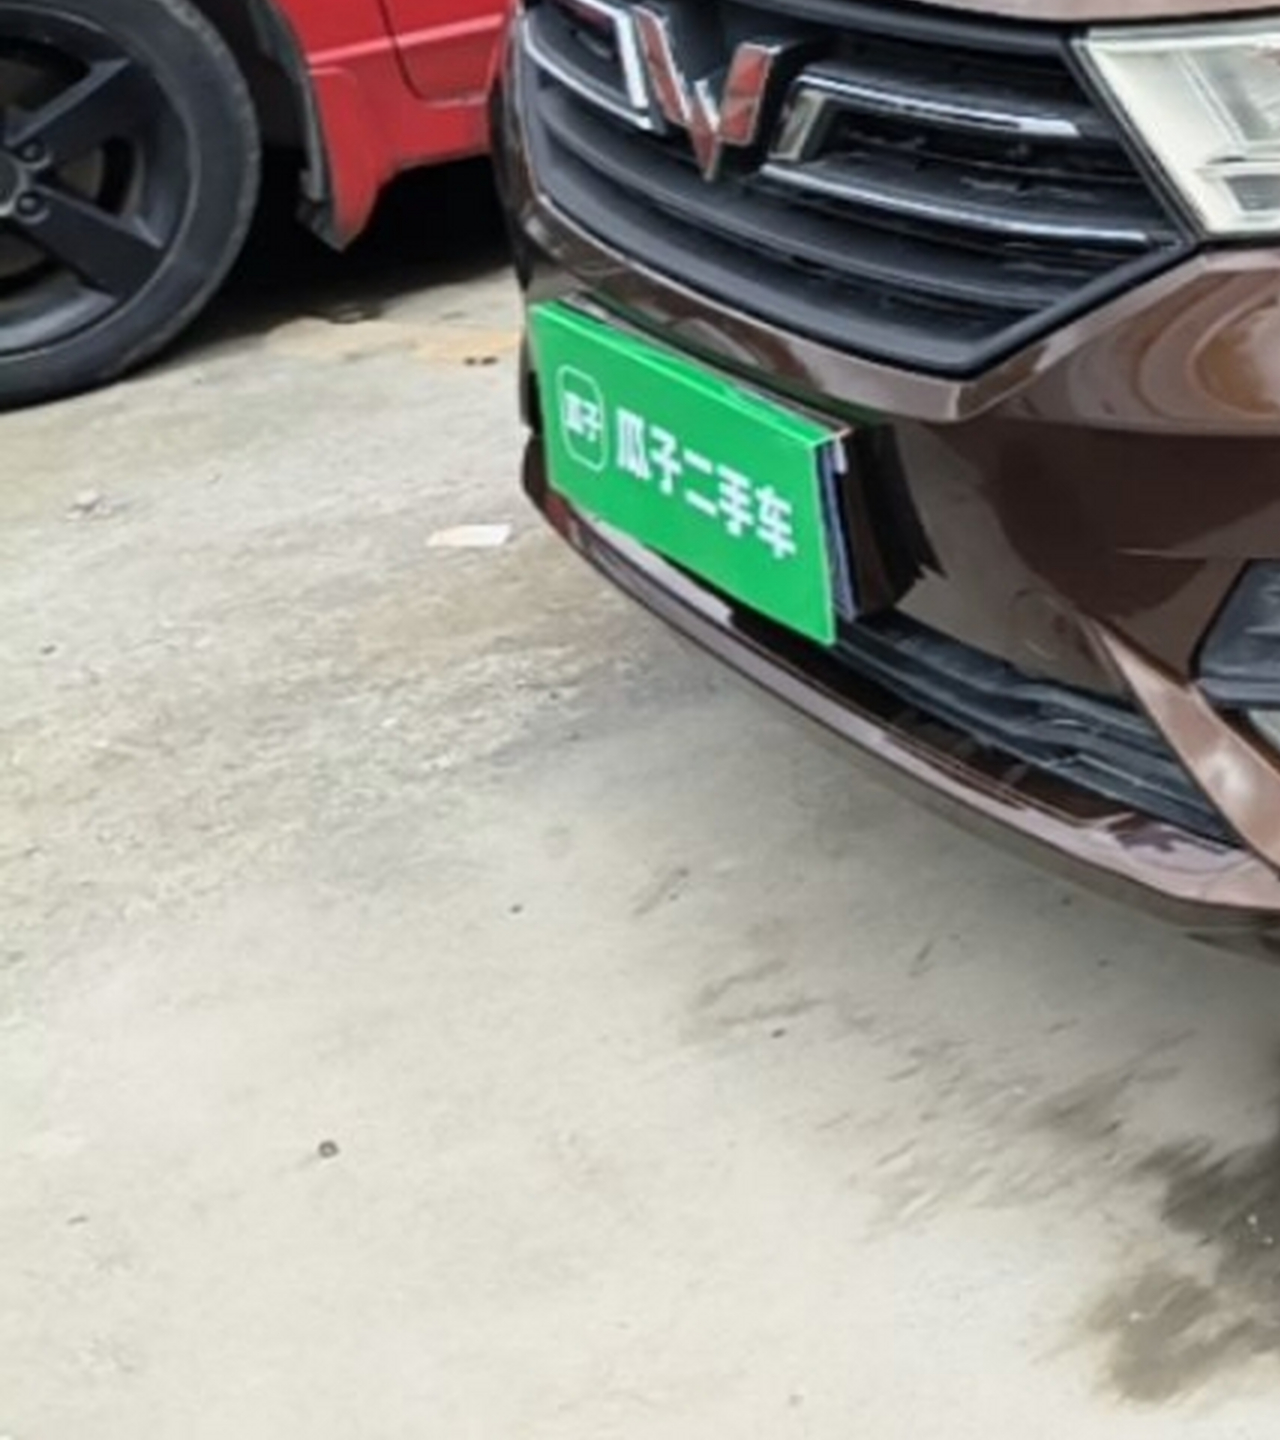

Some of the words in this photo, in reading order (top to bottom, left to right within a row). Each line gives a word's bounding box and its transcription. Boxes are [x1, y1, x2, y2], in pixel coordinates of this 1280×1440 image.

[616, 408, 797, 560] 瓜子二手车
